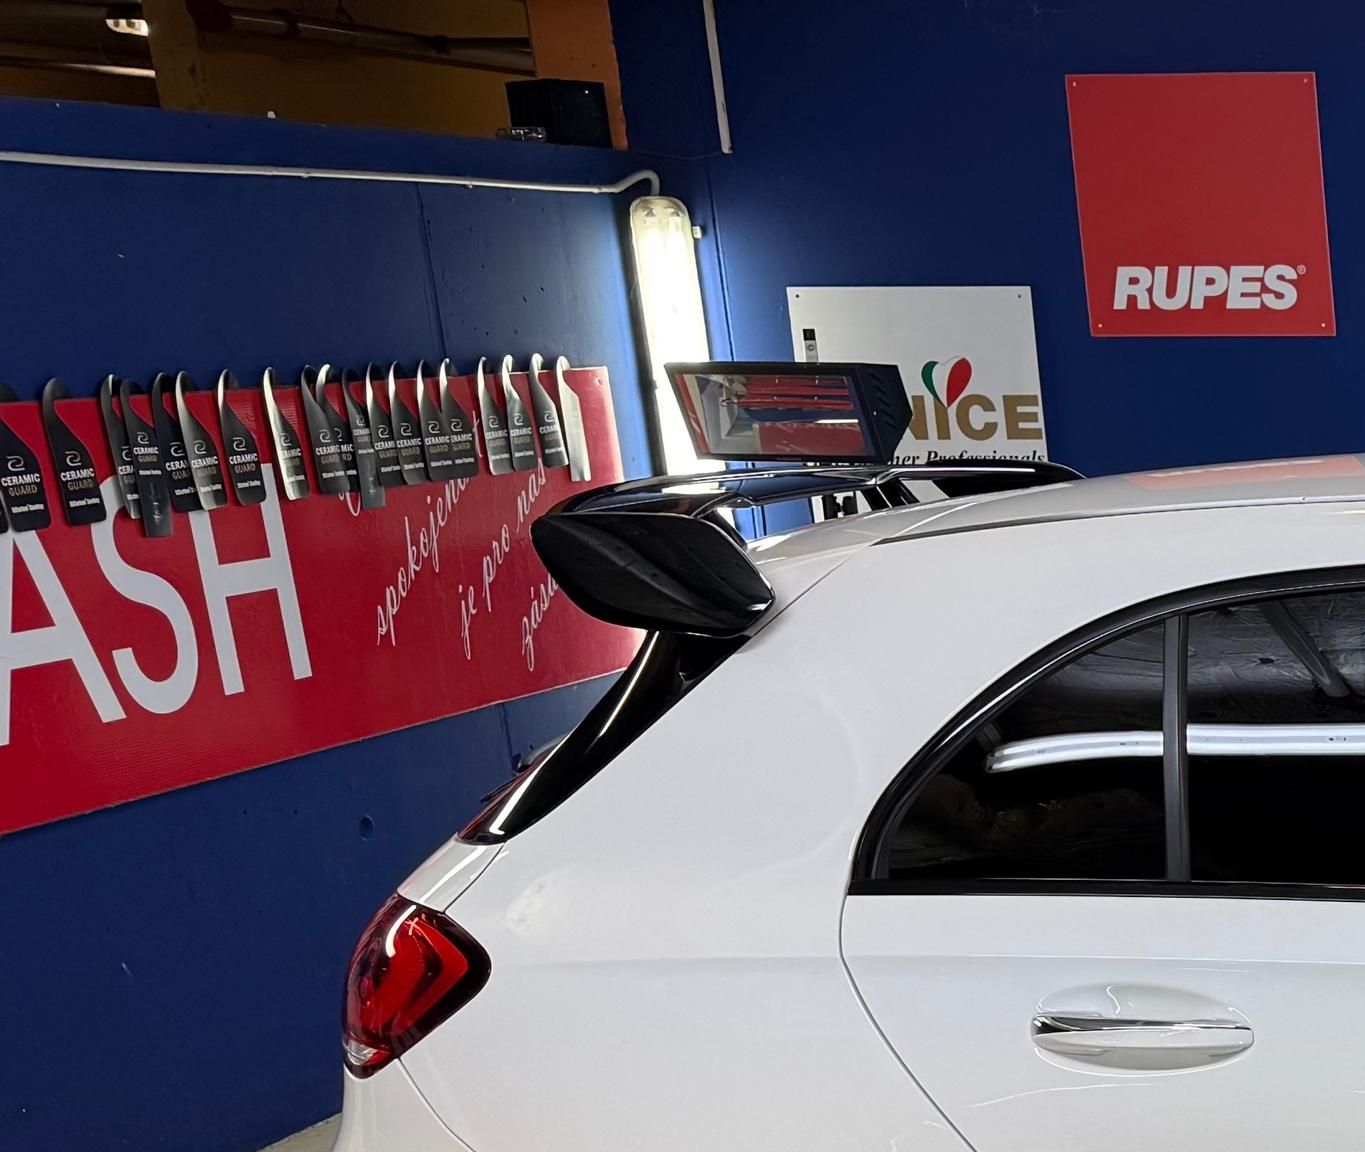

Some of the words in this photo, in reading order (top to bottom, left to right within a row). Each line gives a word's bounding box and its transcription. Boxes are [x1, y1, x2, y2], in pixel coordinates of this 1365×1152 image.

[374, 440, 395, 451] CERAMI
[191, 456, 218, 468] CERAMIC
[229, 452, 258, 465] CERAMIC
[1, 473, 40, 487] CERAMIC
[60, 467, 95, 482] CERAMIC
[9, 484, 38, 497] GUARD
[67, 479, 94, 491] GUARD
[482, 523, 510, 613] pro
